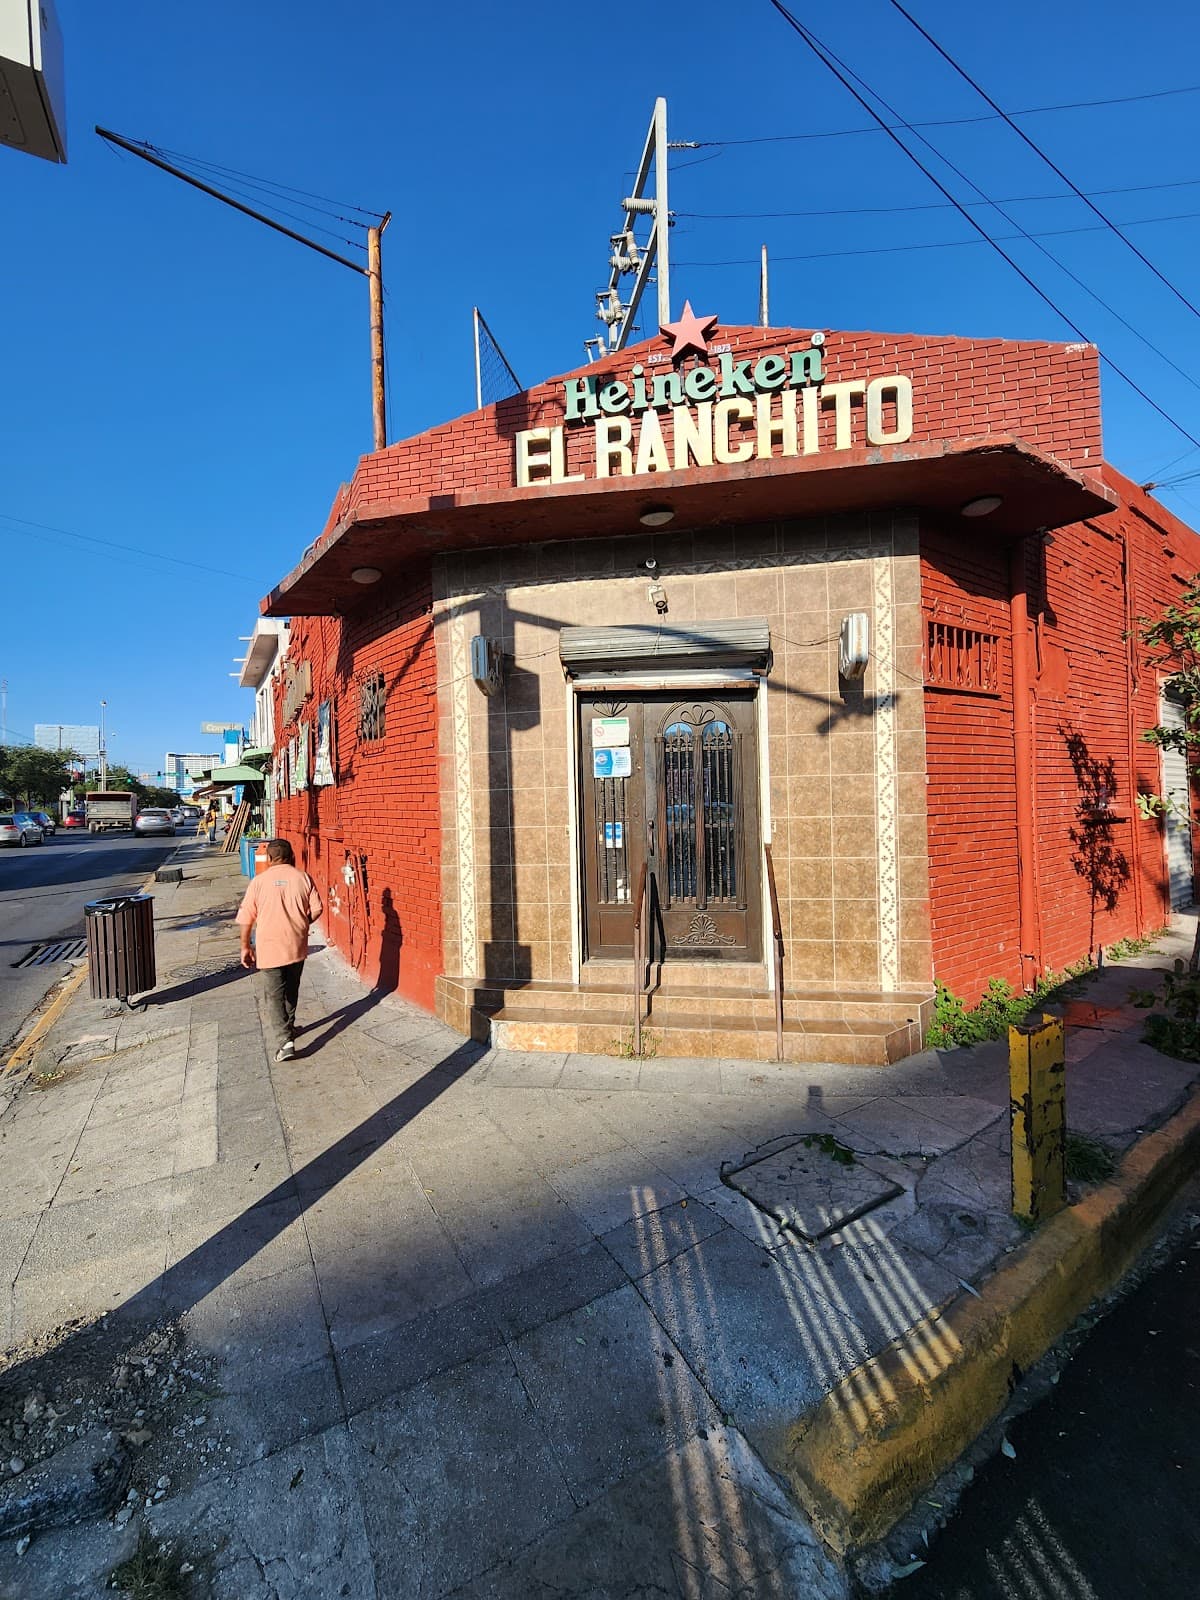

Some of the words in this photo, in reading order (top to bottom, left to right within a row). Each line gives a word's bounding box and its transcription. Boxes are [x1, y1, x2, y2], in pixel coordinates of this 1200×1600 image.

[563, 348, 825, 420] Heineken
[515, 426, 585, 488] EL
[595, 374, 914, 479] RANCHITO
